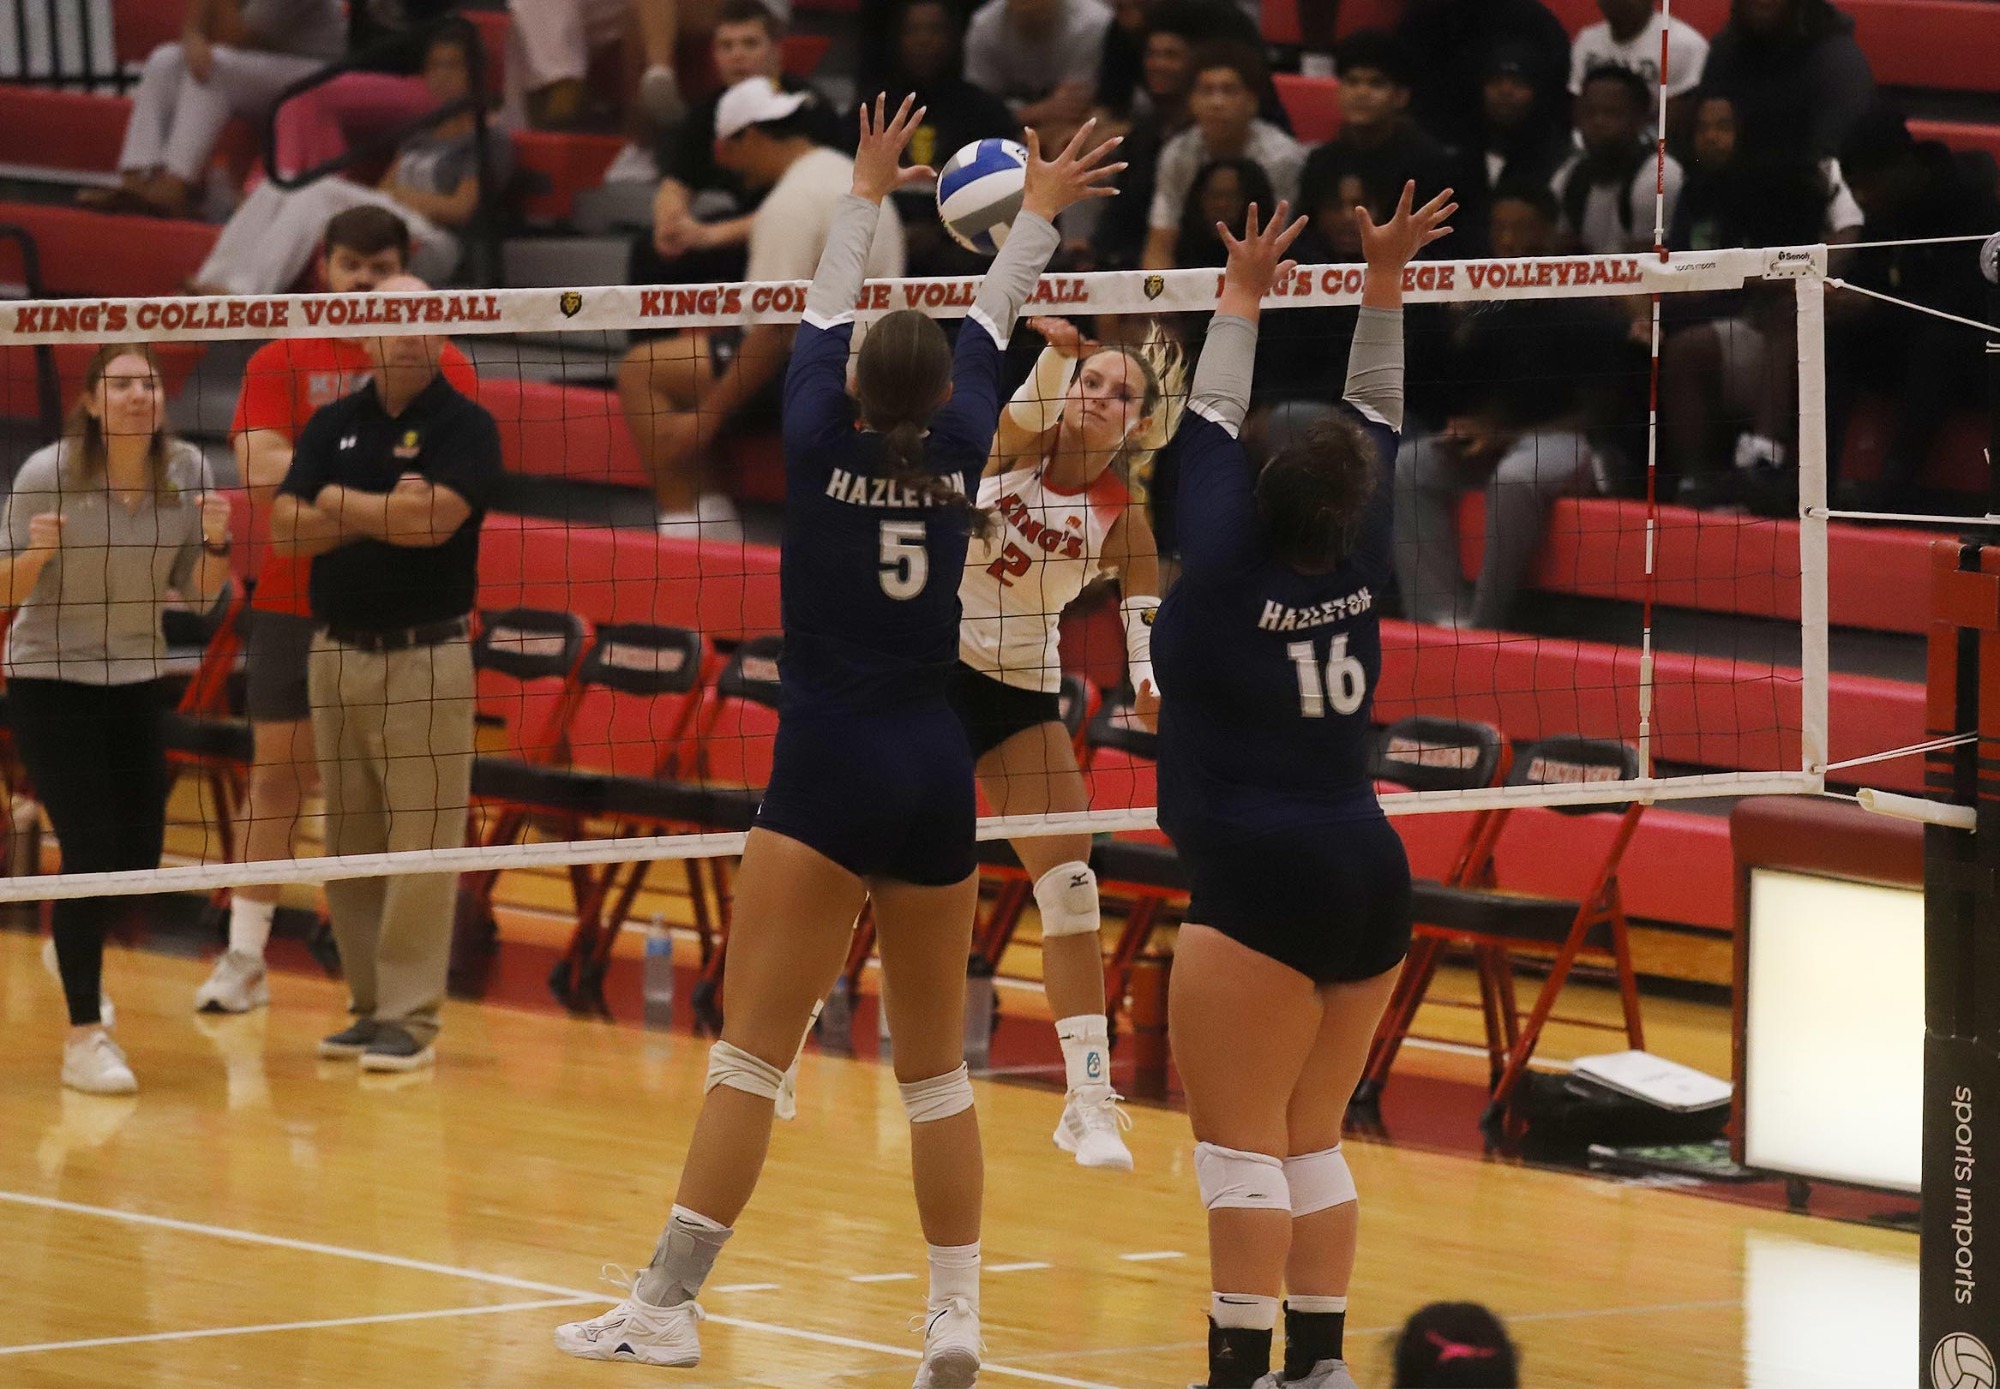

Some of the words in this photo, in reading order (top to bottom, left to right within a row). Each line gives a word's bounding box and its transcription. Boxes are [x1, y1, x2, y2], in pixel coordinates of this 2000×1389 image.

[640, 286, 742, 316] KING'S
[903, 279, 1089, 308] VOLLALL
[1321, 266, 1455, 295] COEGE
[1466, 260, 1643, 289] VOLLEYBALL
[14, 302, 127, 333] KING'S
[136, 301, 289, 330] COLLEGE
[301, 296, 501, 326] VOLLEYBALL
[995, 493, 1084, 558] KING'S
[879, 520, 929, 600] 5
[986, 542, 1032, 587] 2
[1257, 586, 1372, 631] HAZLETON
[1287, 632, 1366, 718] 16
[1951, 1085, 1975, 1182] sports
[1951, 1187, 1975, 1305] imports
